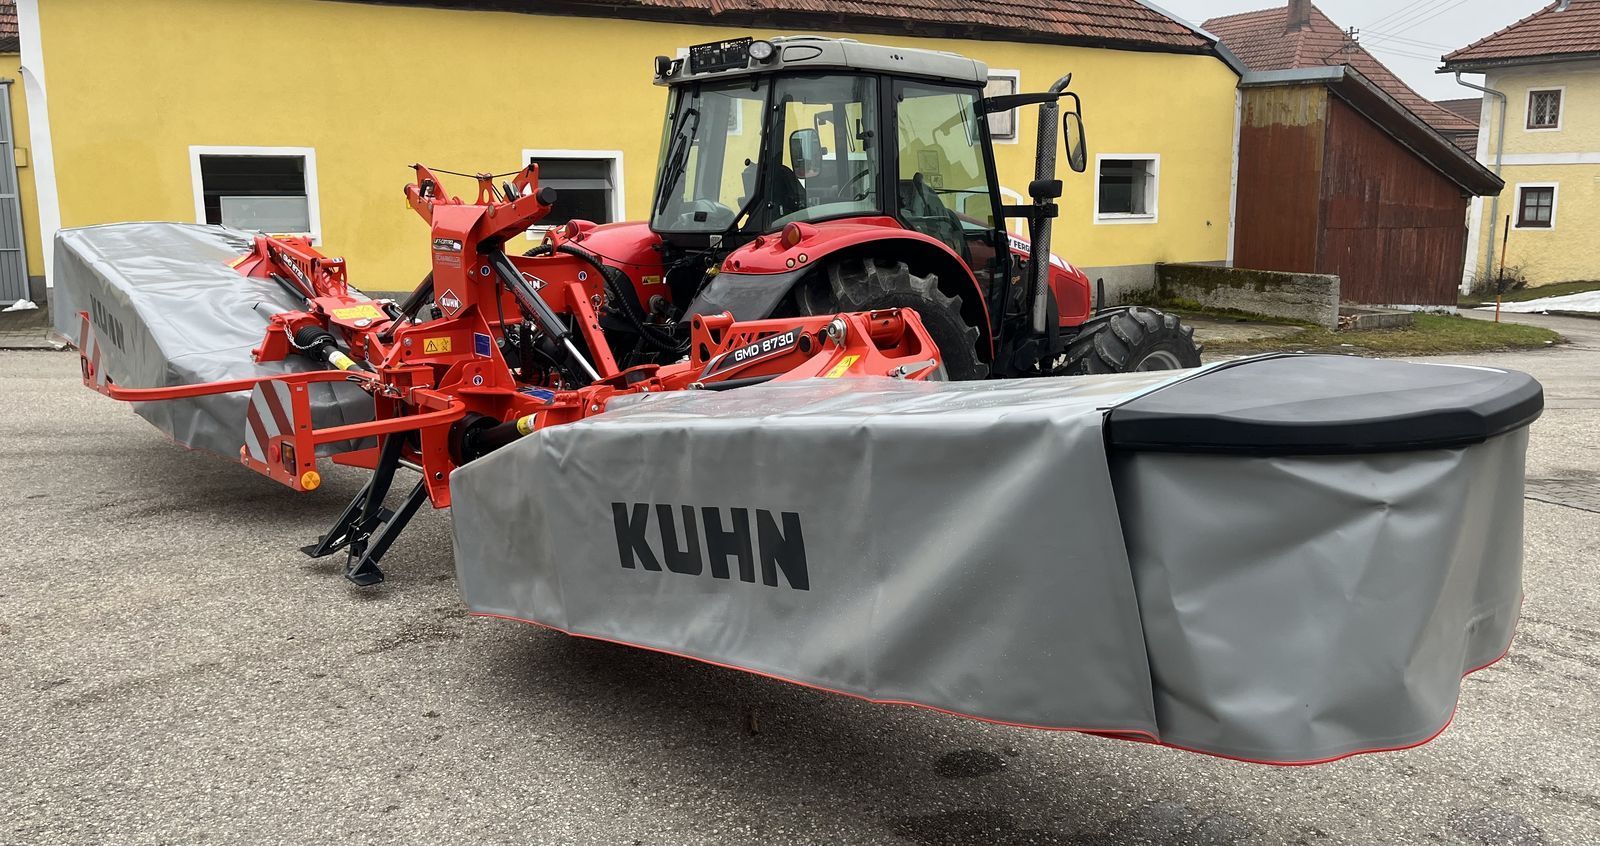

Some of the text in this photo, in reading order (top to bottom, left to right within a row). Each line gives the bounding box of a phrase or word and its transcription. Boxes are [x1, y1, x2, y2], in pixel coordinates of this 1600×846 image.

[1013, 240, 1031, 252] FERG
[441, 297, 460, 308] KUHN
[89, 292, 126, 354] KUHN
[734, 332, 794, 362] GMD 8730
[611, 502, 810, 591] KUHN
